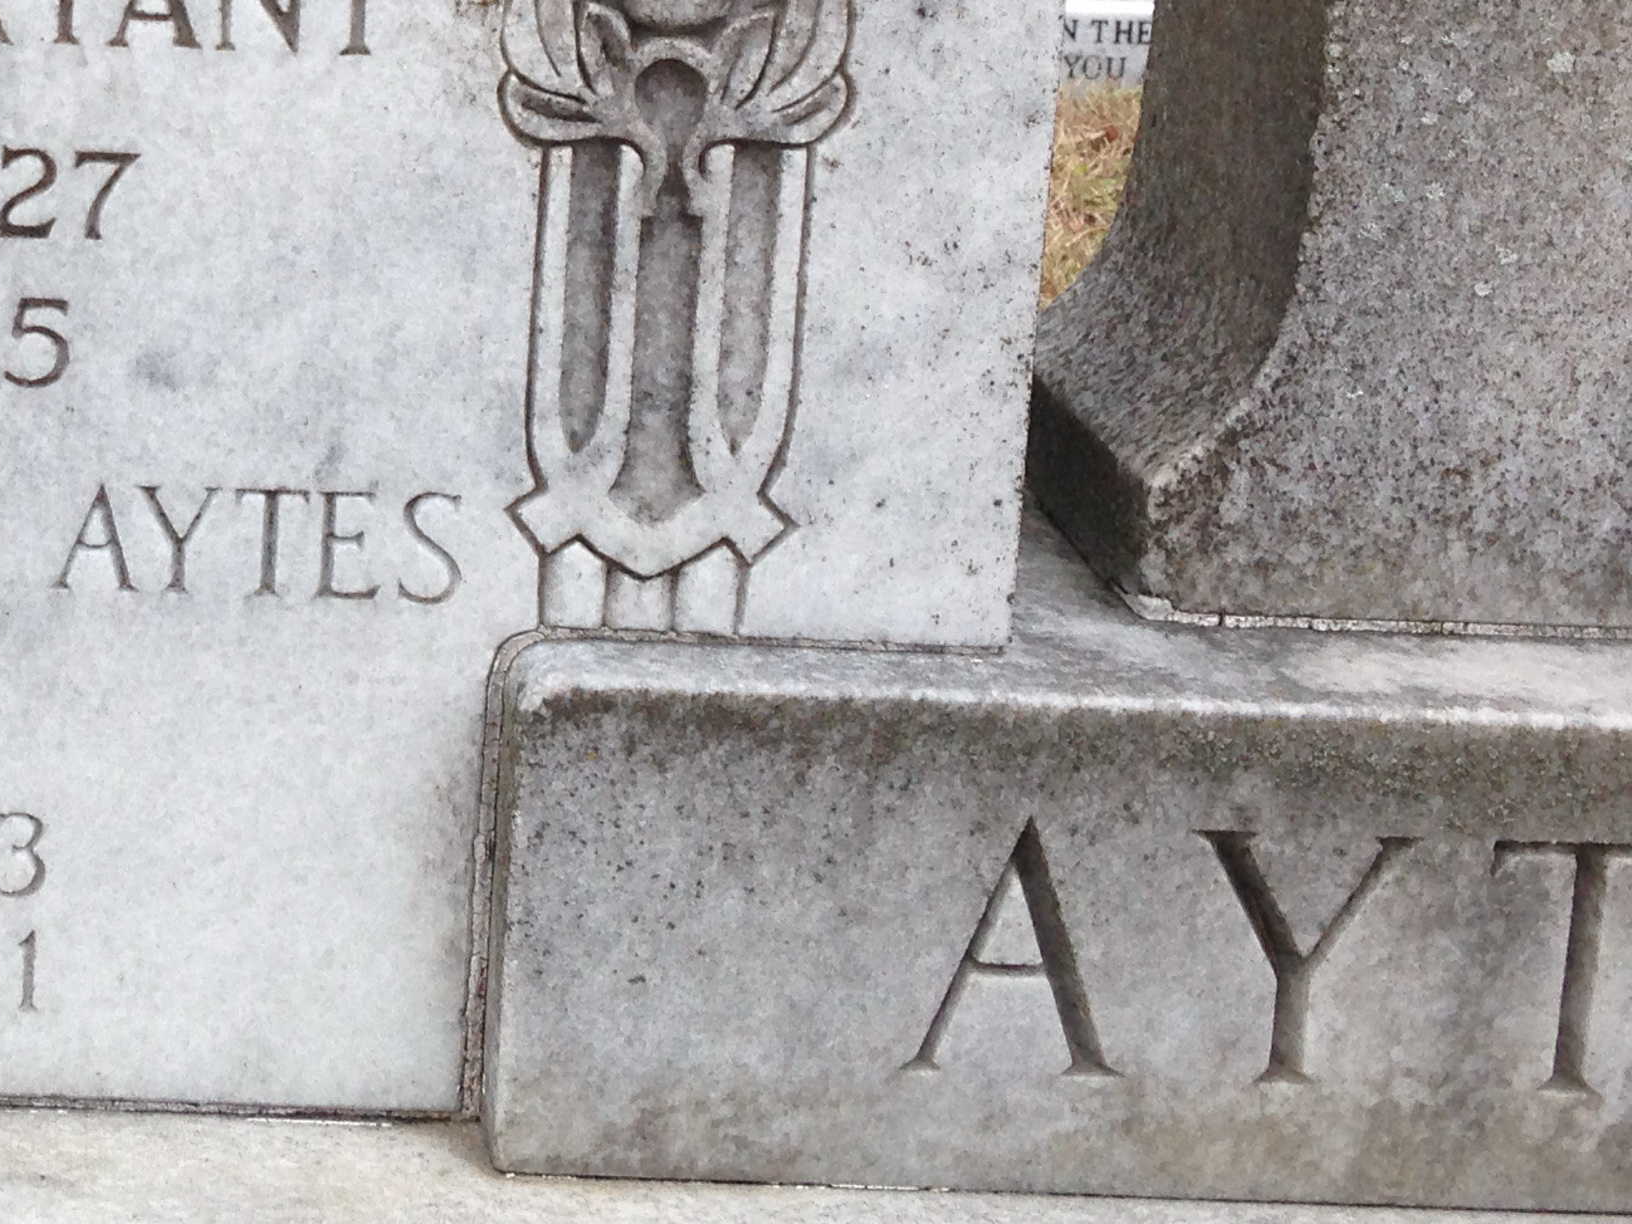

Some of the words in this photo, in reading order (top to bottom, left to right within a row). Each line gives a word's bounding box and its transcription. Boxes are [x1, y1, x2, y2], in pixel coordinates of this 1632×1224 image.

[1063, 53, 1126, 80] YOU
[1090, 19, 1152, 45] THE
[51, 482, 463, 604] AYTES
[896, 814, 1632, 1096] AYT
